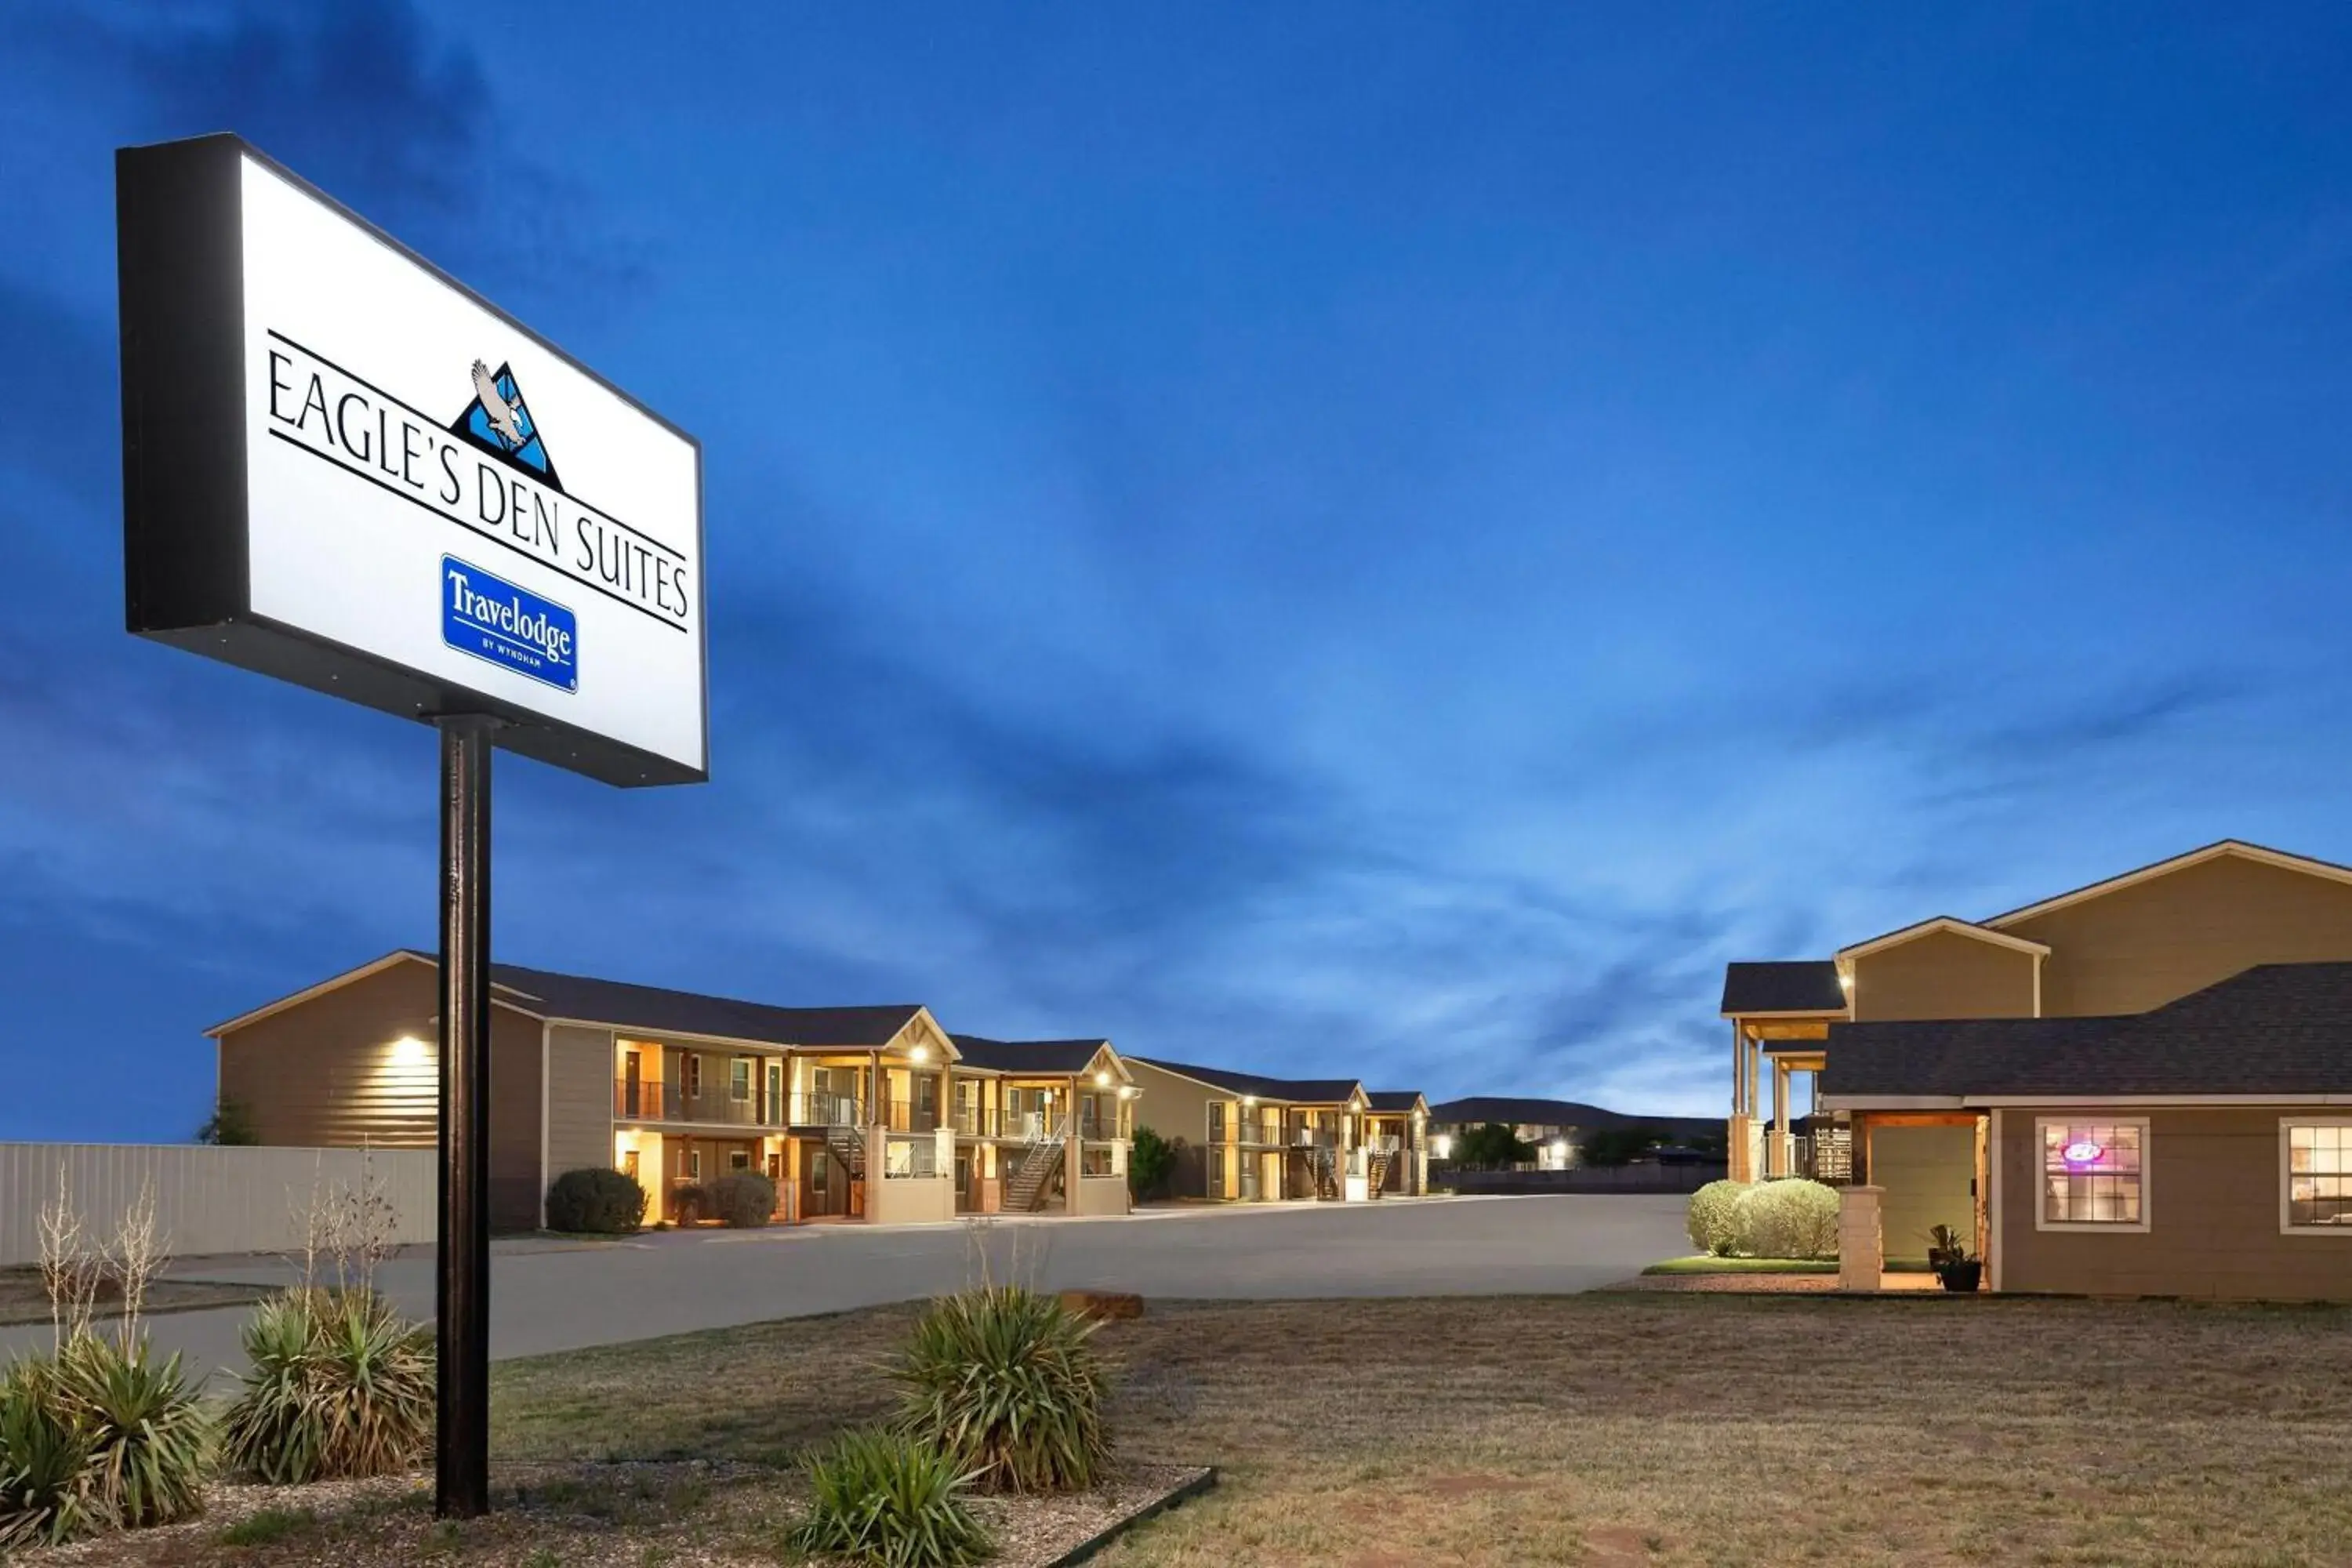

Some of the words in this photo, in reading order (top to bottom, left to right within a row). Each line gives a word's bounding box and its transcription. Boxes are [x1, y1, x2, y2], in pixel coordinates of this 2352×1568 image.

[269, 349, 461, 506] EAGLE'S
[477, 463, 559, 556] DEN
[576, 517, 688, 618] SUITES
[448, 569, 572, 662] Travelodge
[482, 637, 494, 650] BY
[496, 644, 541, 669] WYNDHAM
